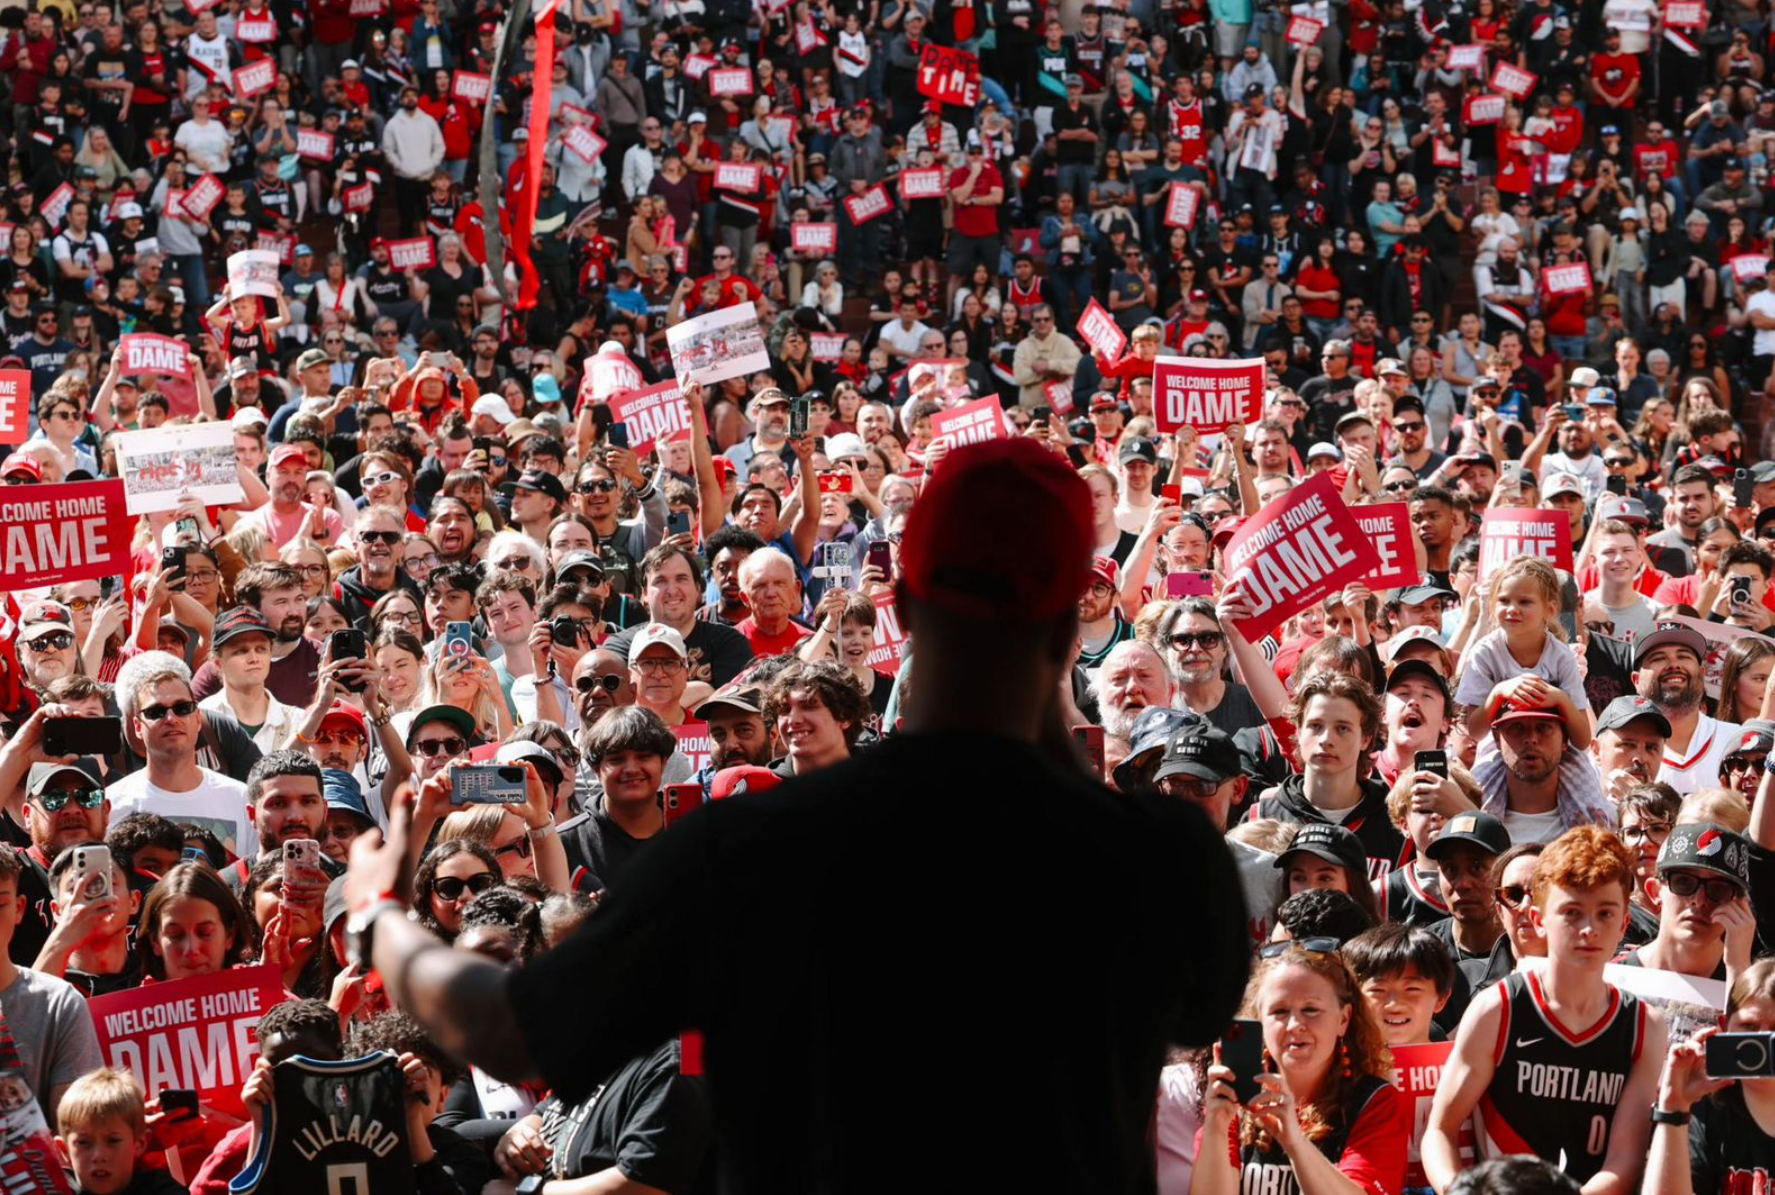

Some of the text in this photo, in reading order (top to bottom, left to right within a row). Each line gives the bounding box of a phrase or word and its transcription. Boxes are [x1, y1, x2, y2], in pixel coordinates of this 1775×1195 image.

[925, 49, 978, 74] DAME
[713, 75, 748, 93] DAME
[924, 67, 977, 106] TIME
[1181, 125, 1200, 139] 32
[718, 172, 755, 188] DAME
[905, 178, 941, 194] DAME
[797, 229, 832, 247] DAME
[392, 247, 430, 267] DAME
[1548, 273, 1588, 292] DAME
[1082, 315, 1119, 361] DAME
[129, 346, 185, 374] DAME
[1166, 374, 1250, 390] WELCOME HOME
[620, 392, 661, 418] WELCOME
[1167, 389, 1251, 425] DAME
[624, 400, 692, 449] DAME
[940, 406, 994, 434] WELCOME HOME
[942, 420, 997, 450] DAME
[0, 496, 107, 523] COME HOME
[1230, 493, 1327, 570] WELCOME HOME
[1521, 522, 1555, 537] HOME
[0, 517, 110, 575] AME
[1238, 514, 1357, 617] DAME
[679, 737, 710, 752] HOM
[105, 988, 261, 1038] WELCOME HOME
[109, 1016, 262, 1103] DAME
[1517, 1060, 1625, 1106] PORTLAND
[292, 1114, 399, 1161] LILLARD
[1587, 1115, 1606, 1155] 0
